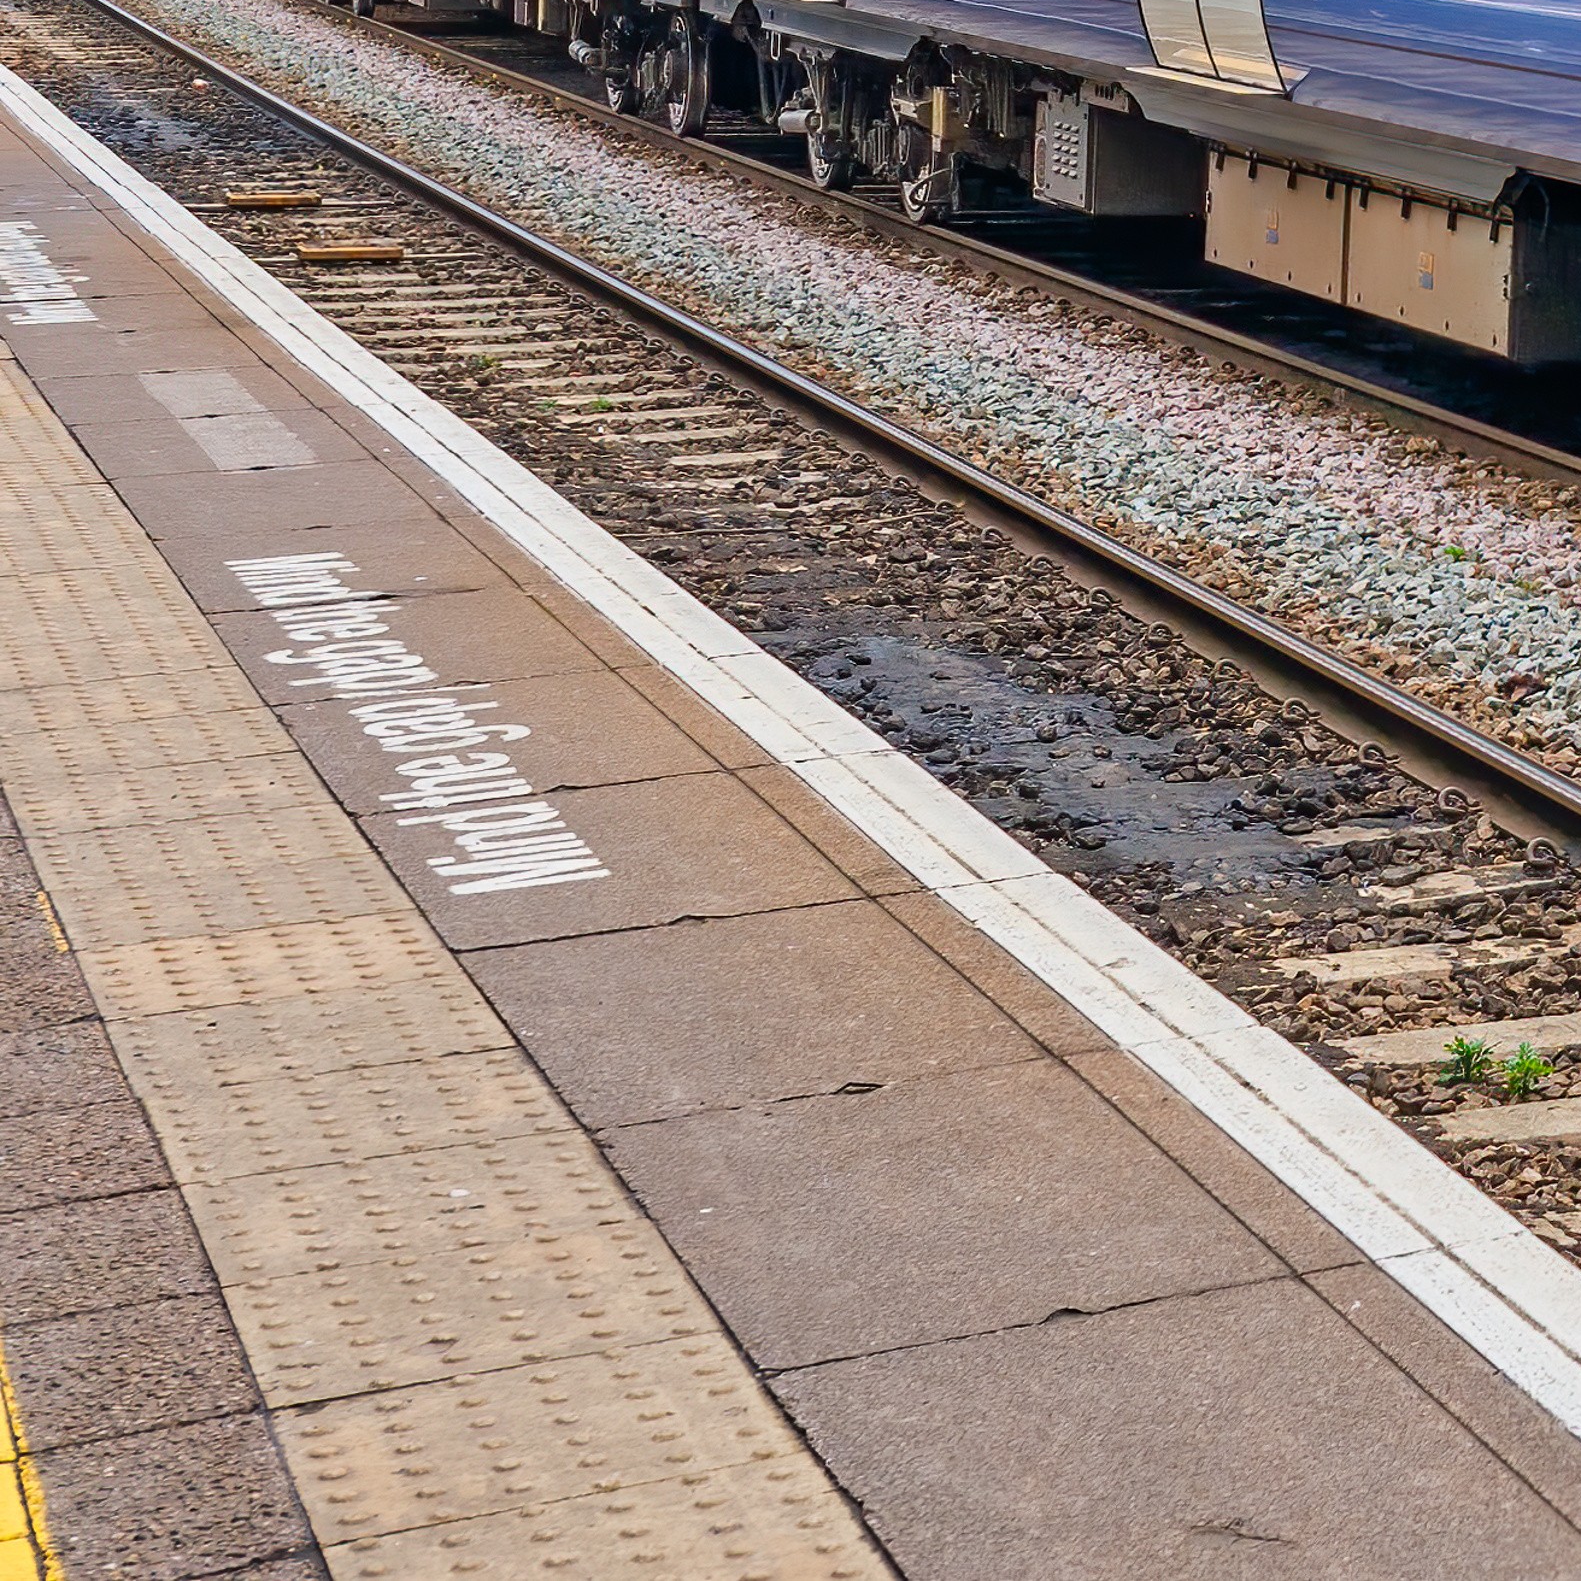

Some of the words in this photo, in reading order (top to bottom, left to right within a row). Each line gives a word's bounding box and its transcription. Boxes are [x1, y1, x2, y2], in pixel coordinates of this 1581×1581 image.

[222, 551, 390, 607] Mind
[347, 697, 532, 754] gap
[378, 752, 534, 811] the
[396, 800, 612, 895] Mind
